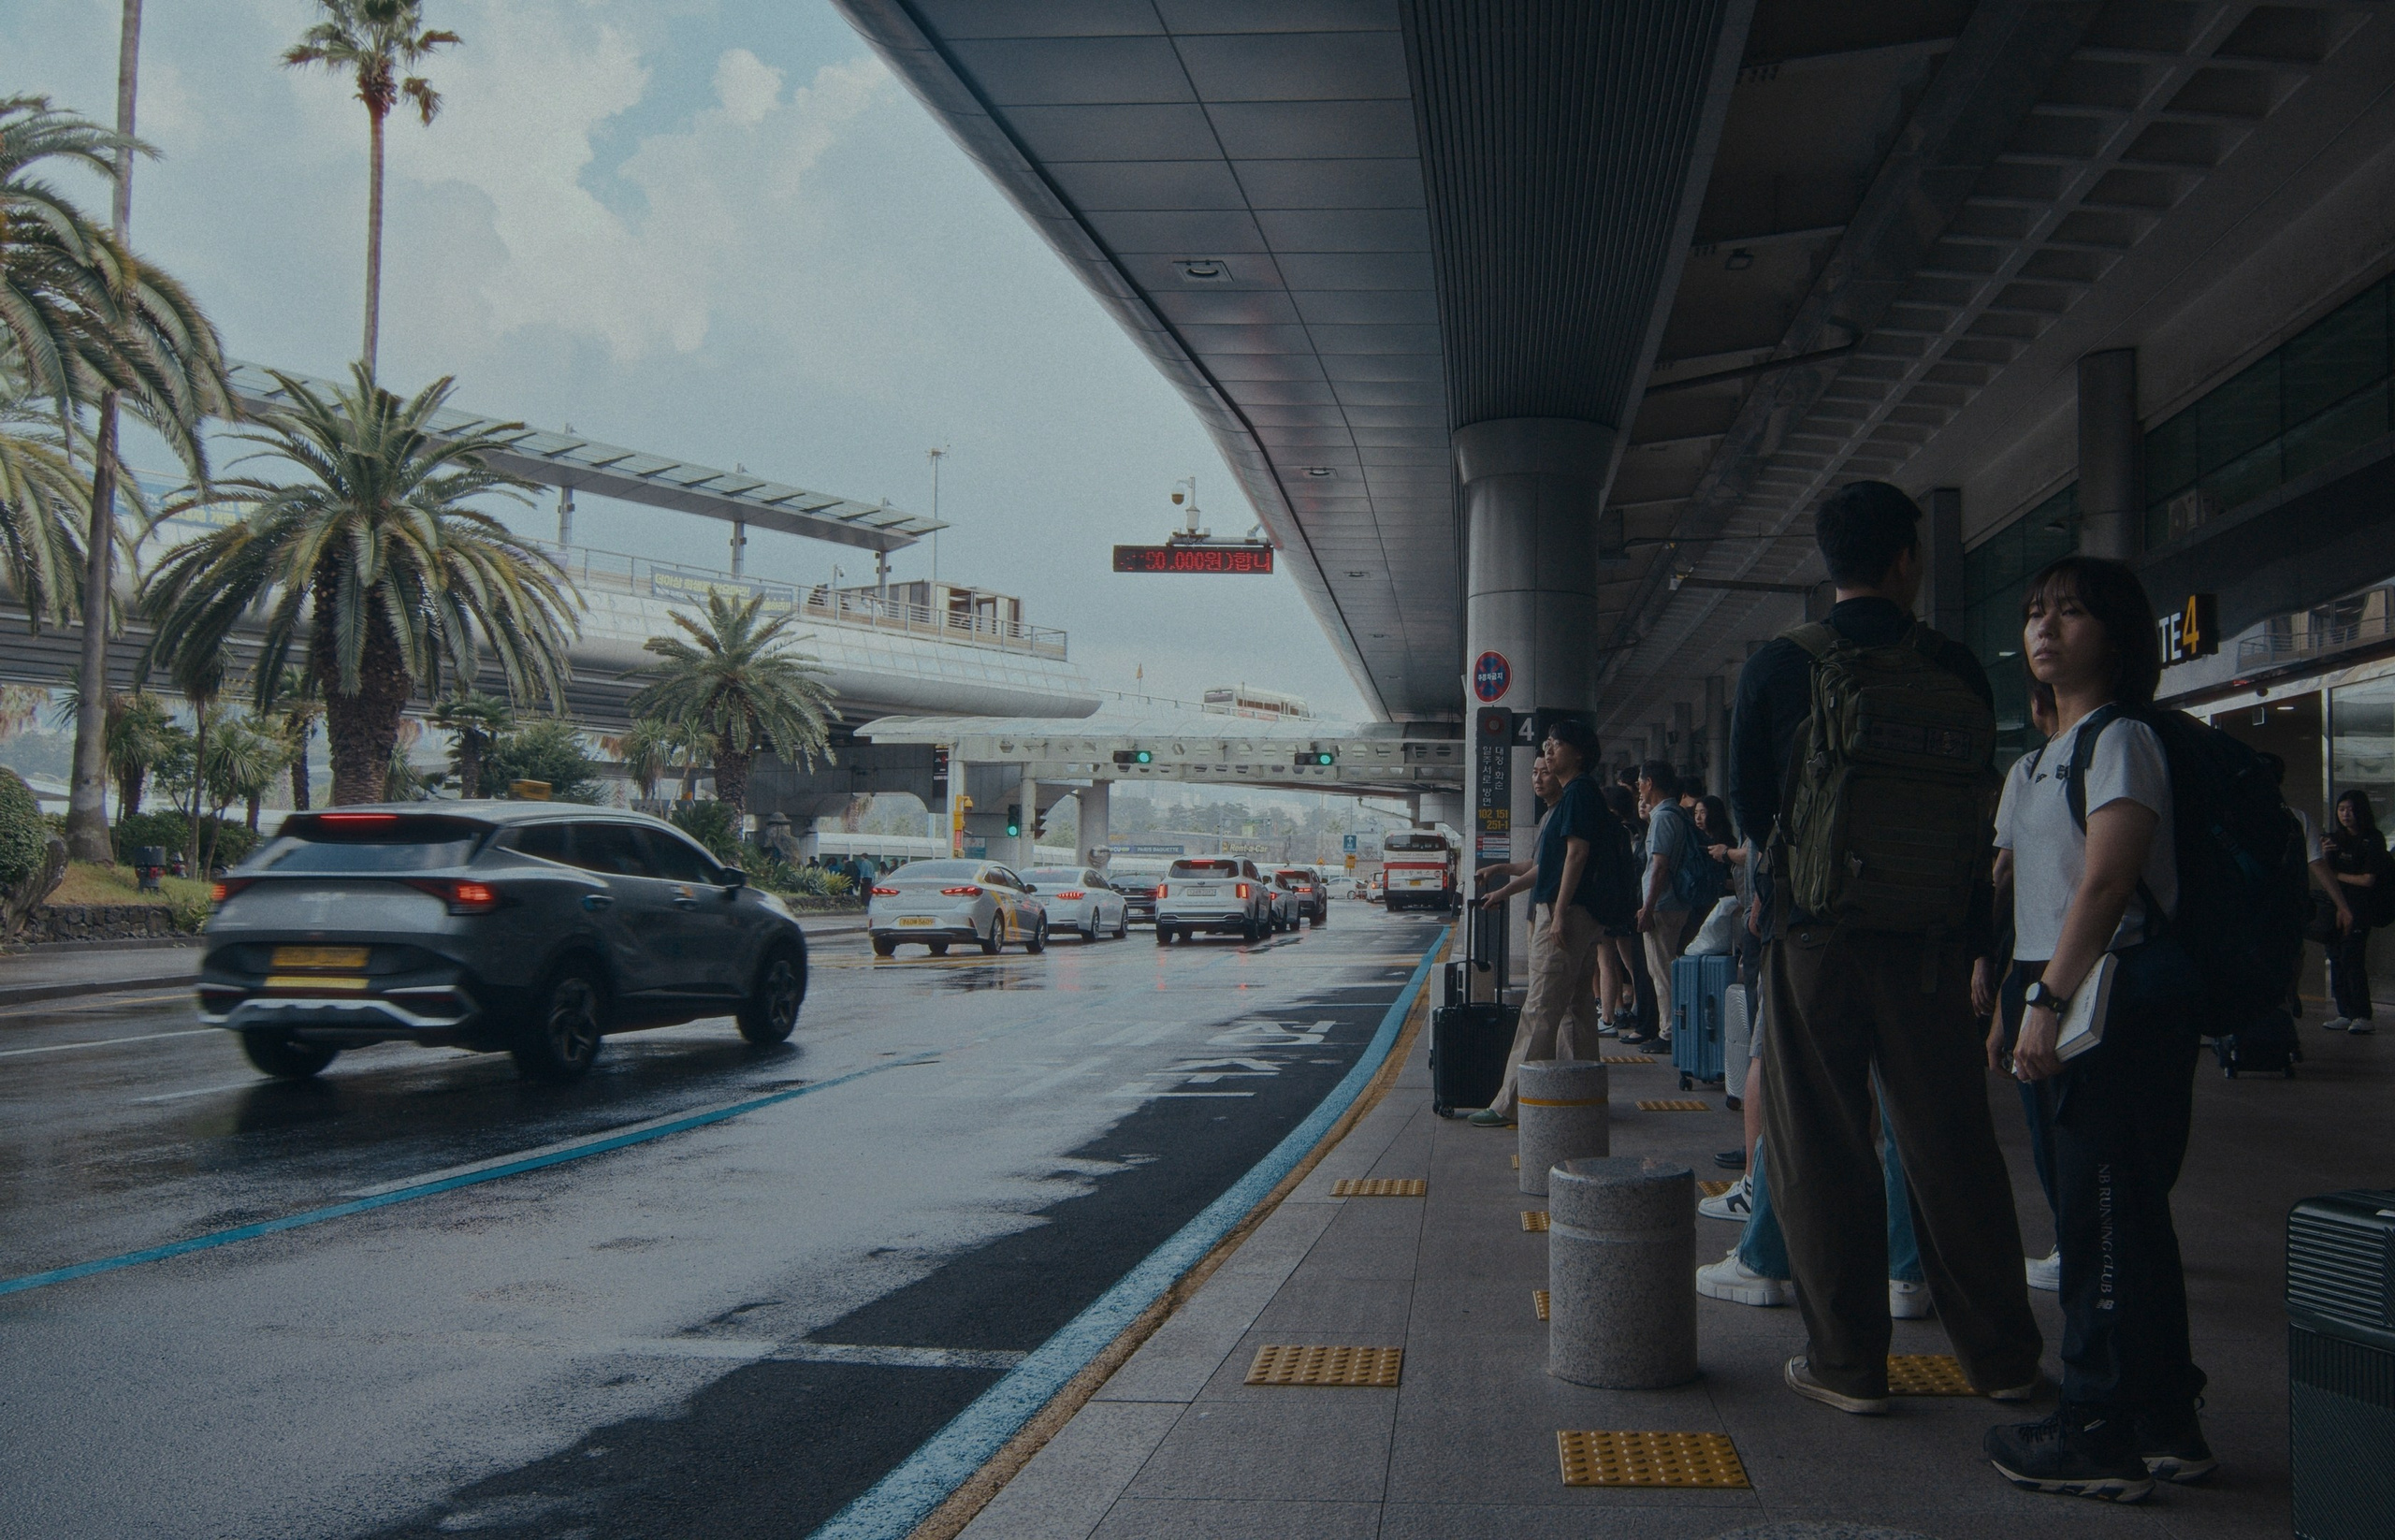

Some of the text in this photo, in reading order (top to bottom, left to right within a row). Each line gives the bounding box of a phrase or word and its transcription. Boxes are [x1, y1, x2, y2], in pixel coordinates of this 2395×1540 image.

[2158, 594, 2200, 663] TE 4
[1477, 672, 1503, 682] 주정차금지
[1517, 718, 1535, 742] 4
[1482, 746, 1492, 806] 일주서로 방면
[1478, 809, 1508, 819] 102 151
[1487, 820, 1508, 830] 251-1
[1229, 843, 1269, 853] Rent-a-Car
[2098, 1187, 2113, 1252] RUNNING
[2100, 1255, 2113, 1293] CLUB
